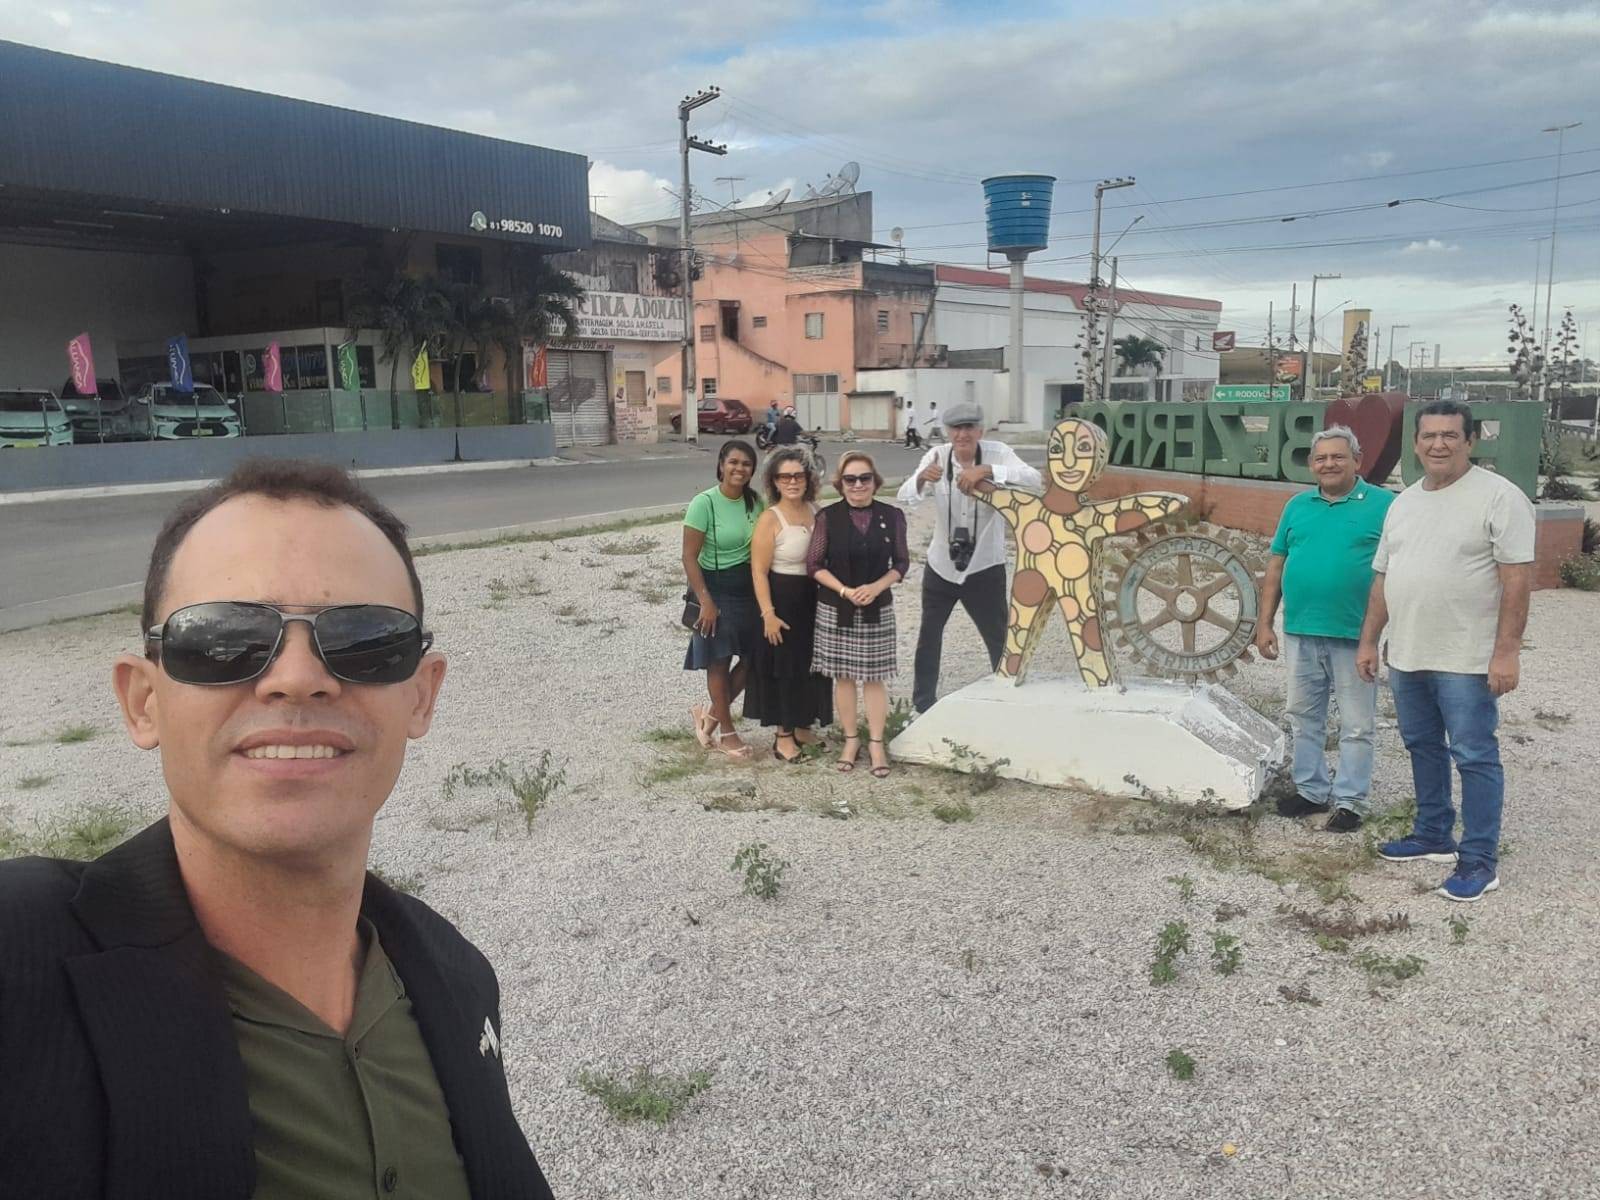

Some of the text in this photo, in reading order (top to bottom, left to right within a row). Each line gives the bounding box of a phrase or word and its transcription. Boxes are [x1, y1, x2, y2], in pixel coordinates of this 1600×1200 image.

[501, 219, 533, 234] 98520
[538, 223, 562, 238] 1070
[632, 298, 684, 319] ADONAI
[1147, 539, 1224, 562] ROTARY
[1125, 622, 1255, 669] INTERNATIONAL
